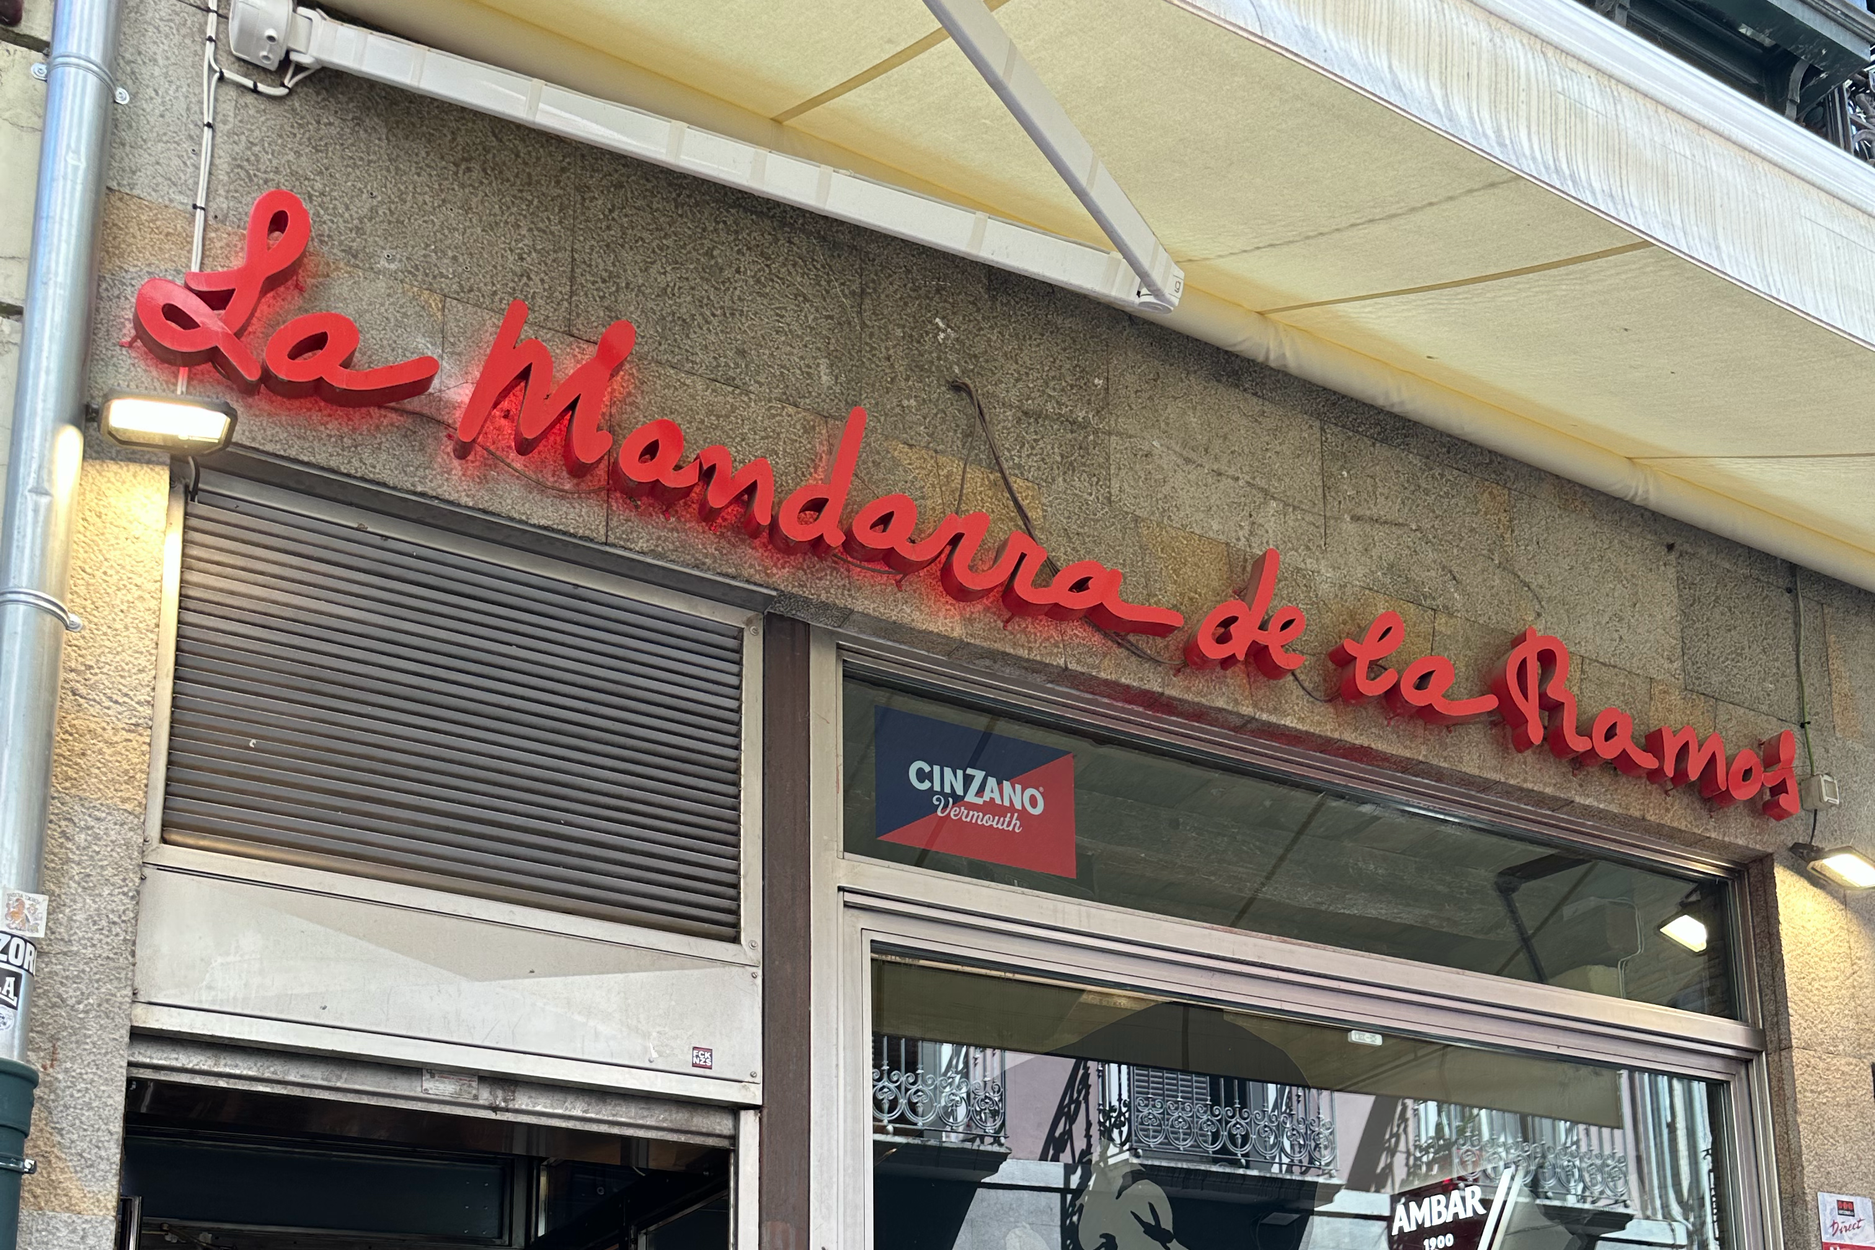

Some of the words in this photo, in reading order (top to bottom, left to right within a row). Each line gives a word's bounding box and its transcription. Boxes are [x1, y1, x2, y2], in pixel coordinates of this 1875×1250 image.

[134, 189, 440, 407] La
[452, 299, 1184, 636] Mandarra
[1184, 547, 1308, 679] de
[1329, 610, 1499, 724] la
[1490, 626, 1801, 821] Ramos
[908, 760, 1045, 816] CINZANO
[932, 794, 1023, 834] Vermouth
[693, 1050, 711, 1059] FCK
[693, 1057, 711, 1065] NZS
[1391, 1184, 1488, 1237] ÁMBAR
[1830, 1217, 1865, 1237] Direct
